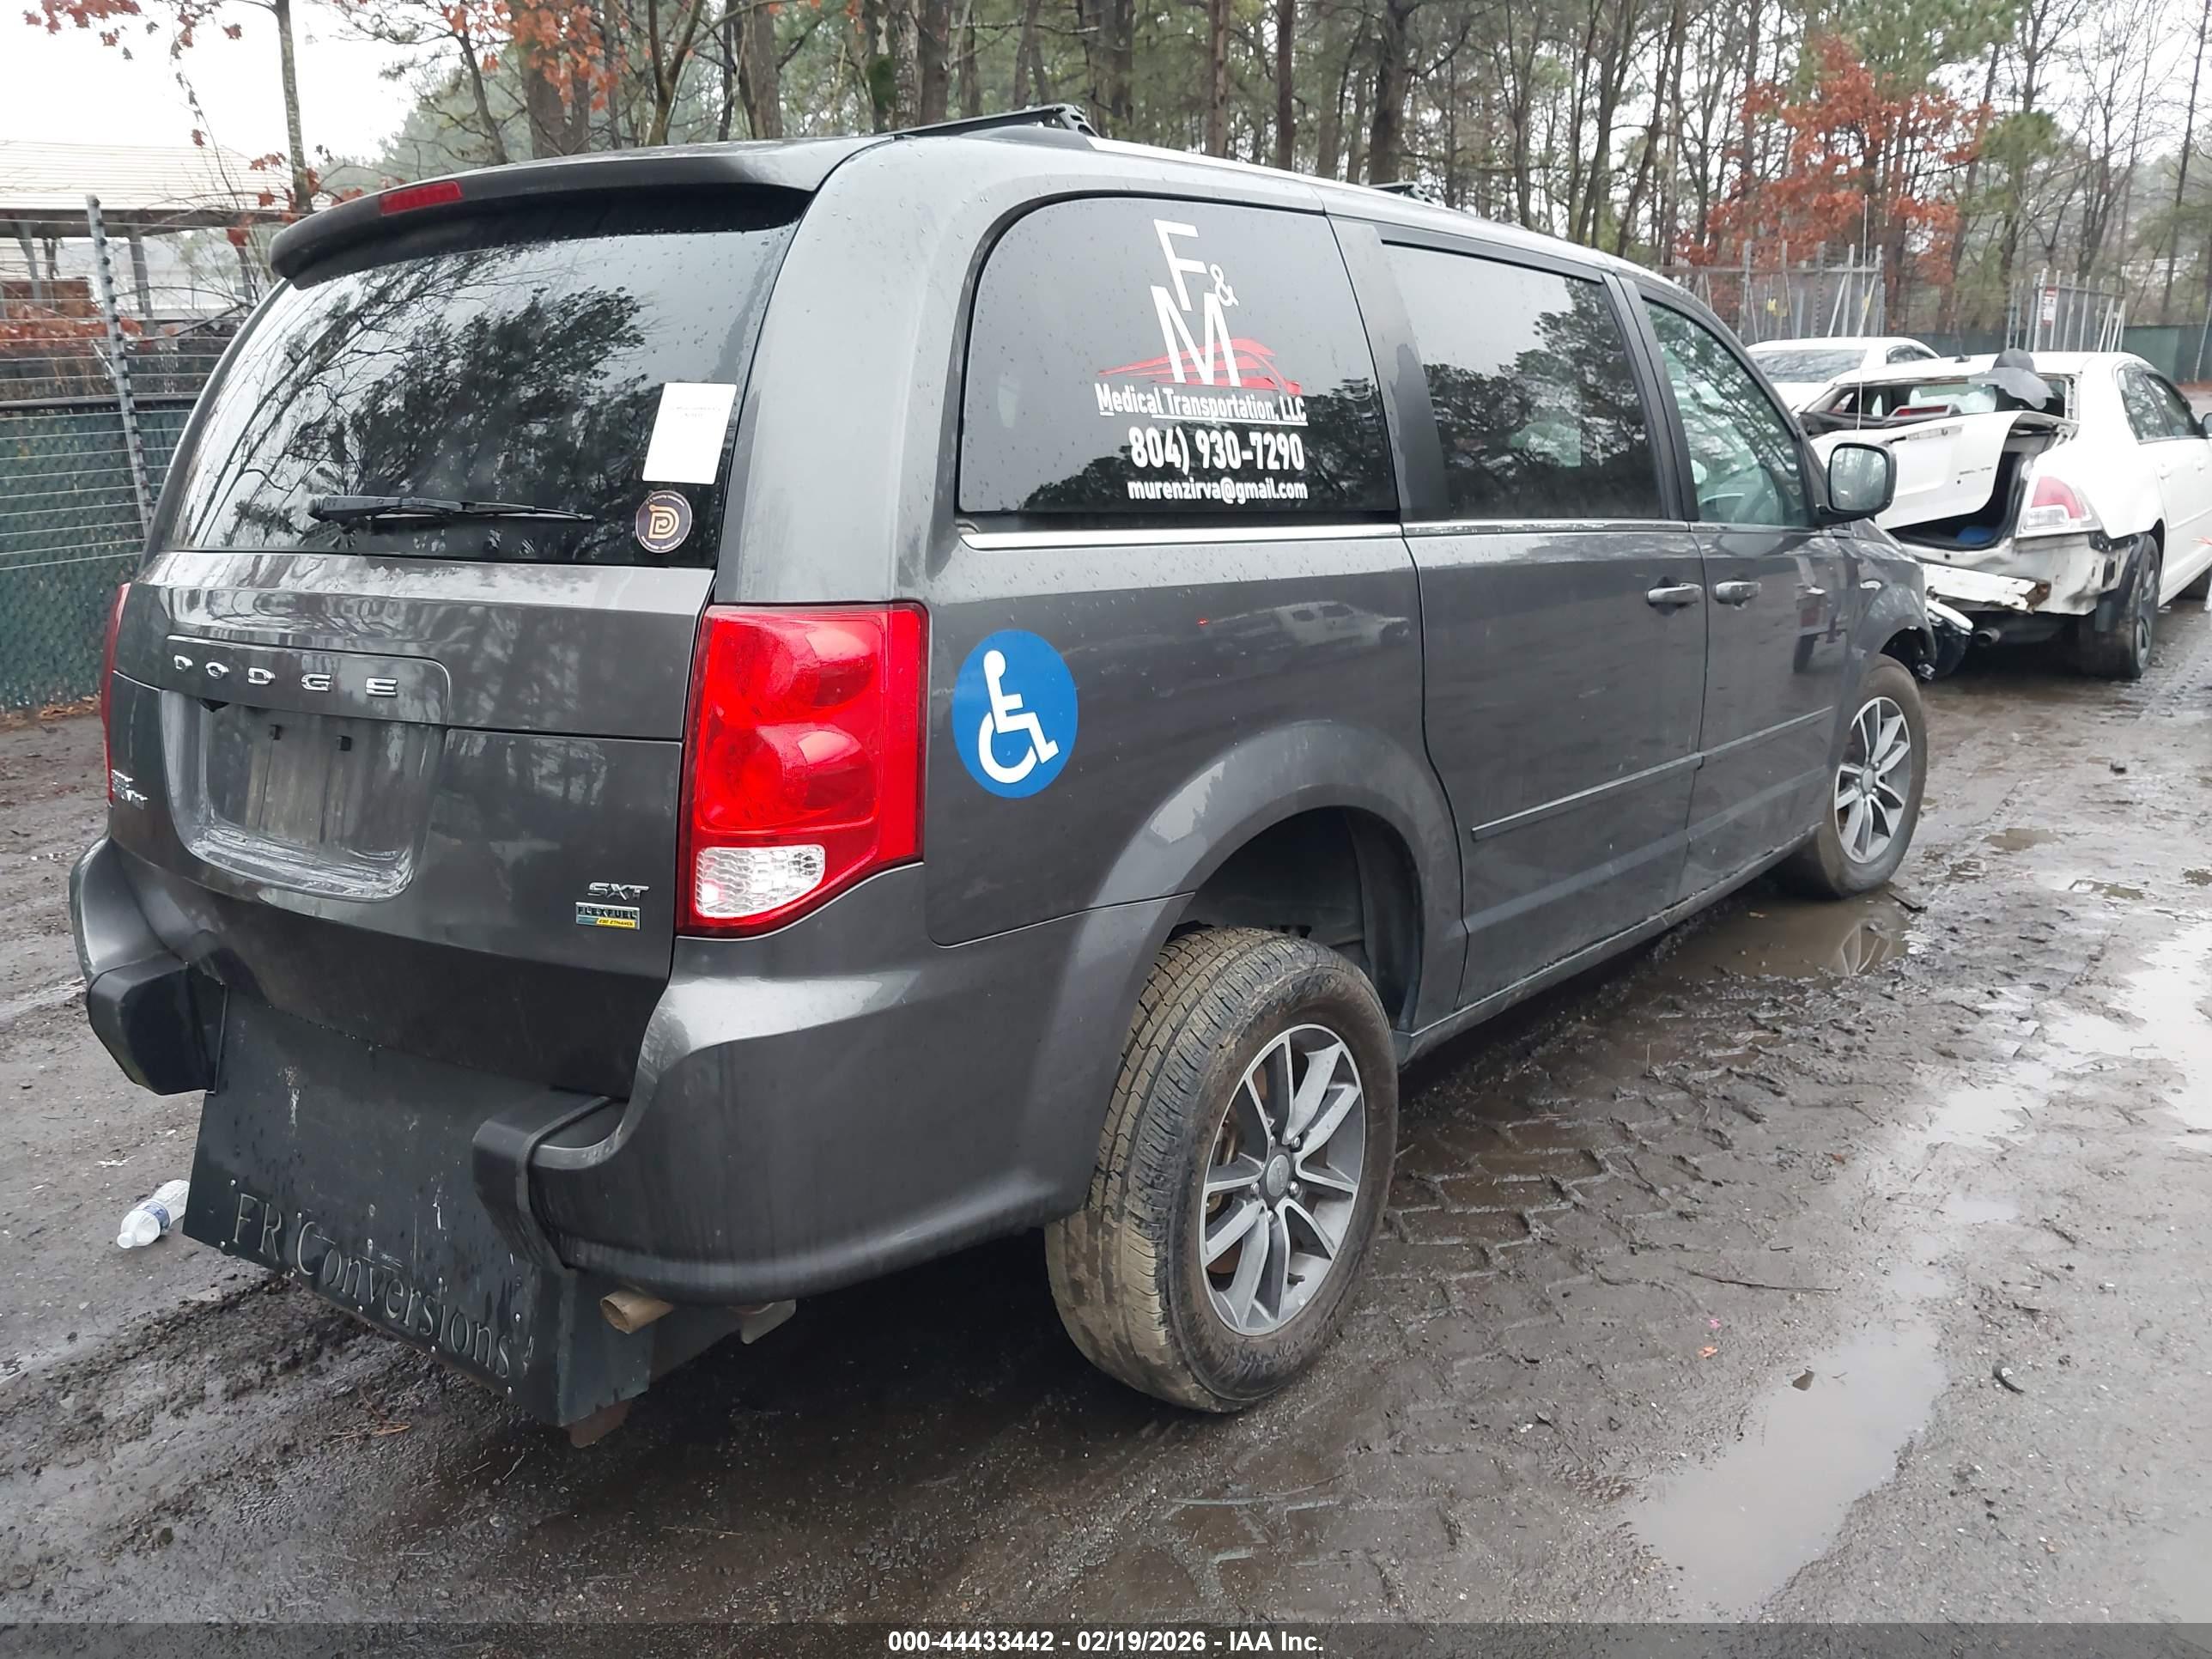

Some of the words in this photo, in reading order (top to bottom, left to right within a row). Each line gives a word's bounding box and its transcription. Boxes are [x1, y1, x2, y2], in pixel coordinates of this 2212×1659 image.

[1153, 219, 1207, 311] F
[1210, 264, 1239, 306] &
[1150, 285, 1242, 387] M
[1095, 382, 1164, 414] Medical
[1163, 386, 1279, 423] Transportation,
[1279, 395, 1308, 421] LLC
[1128, 426, 1190, 476] 804)
[1194, 429, 1305, 471] 930-7290
[1127, 476, 1309, 505] murenzirva@gmail.com
[173, 654, 398, 697] DODGE
[587, 882, 649, 900] SXT
[232, 1193, 282, 1260] FR
[296, 1221, 513, 1379] Conversions
